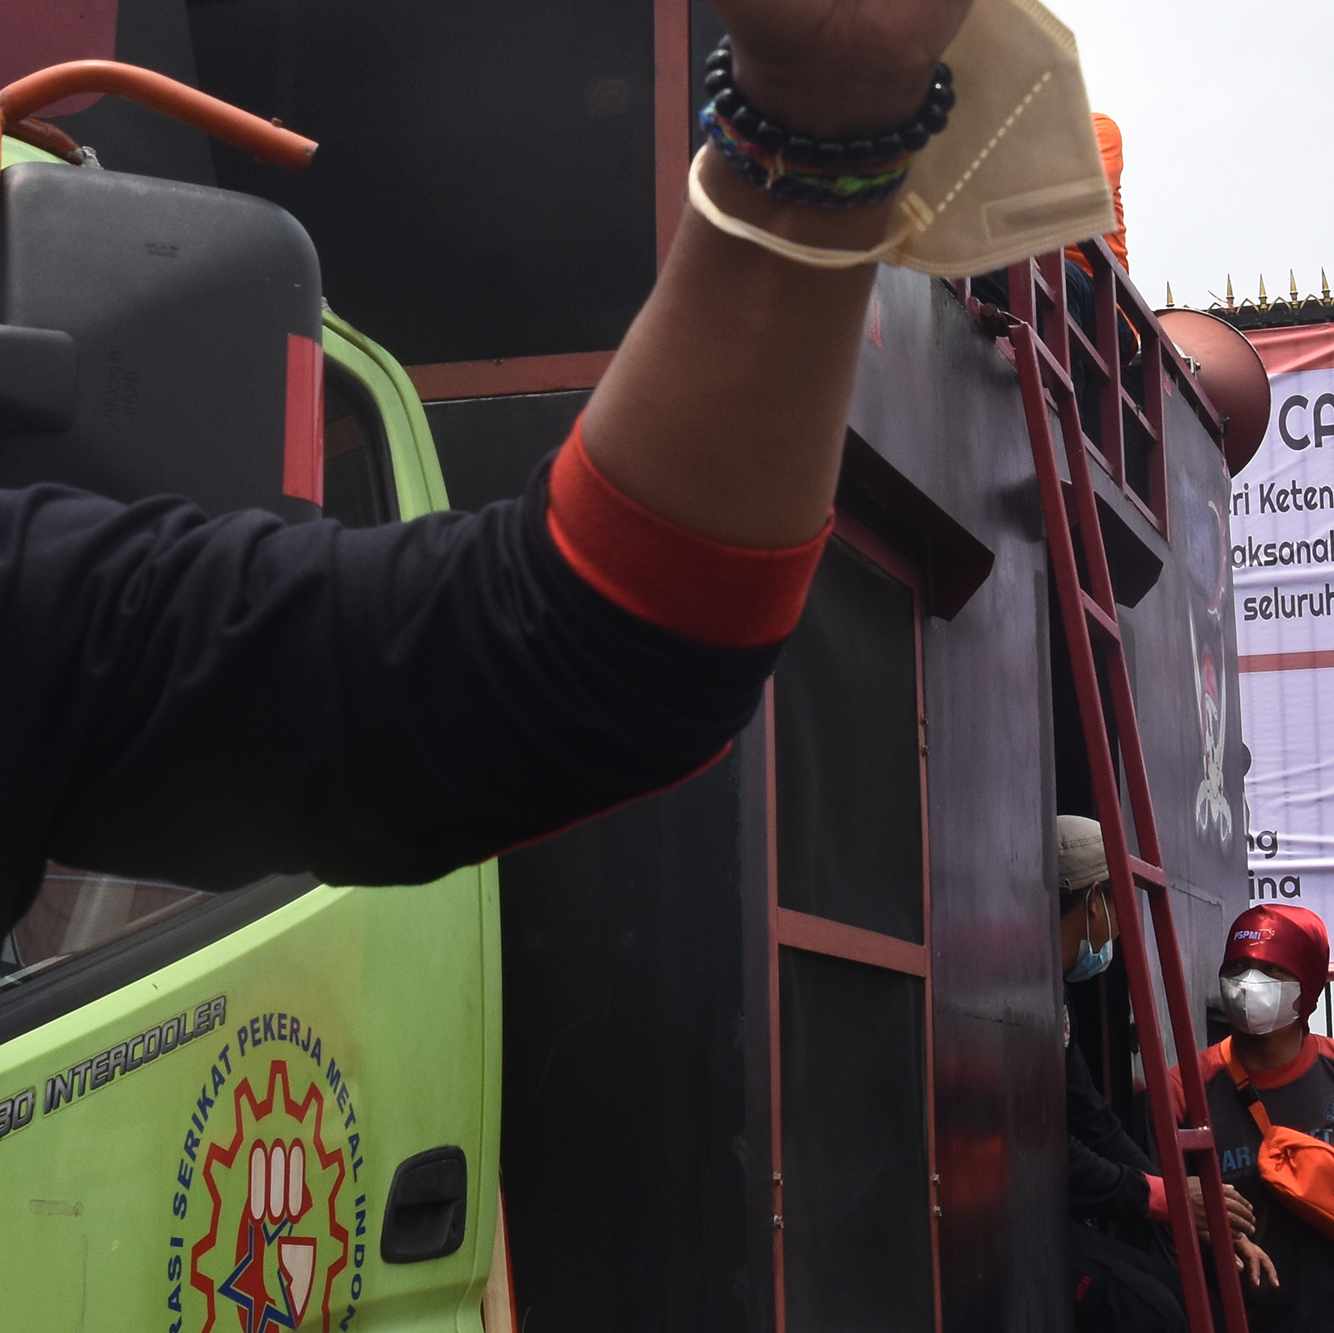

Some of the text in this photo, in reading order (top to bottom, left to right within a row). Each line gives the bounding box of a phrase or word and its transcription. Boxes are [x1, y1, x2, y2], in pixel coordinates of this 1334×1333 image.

[43, 994, 227, 1117] INTERCOOLER
[173, 1044, 233, 1220] SERIKAT
[237, 1012, 322, 1068] PEKERJA
[326, 1058, 364, 1183] METAL
